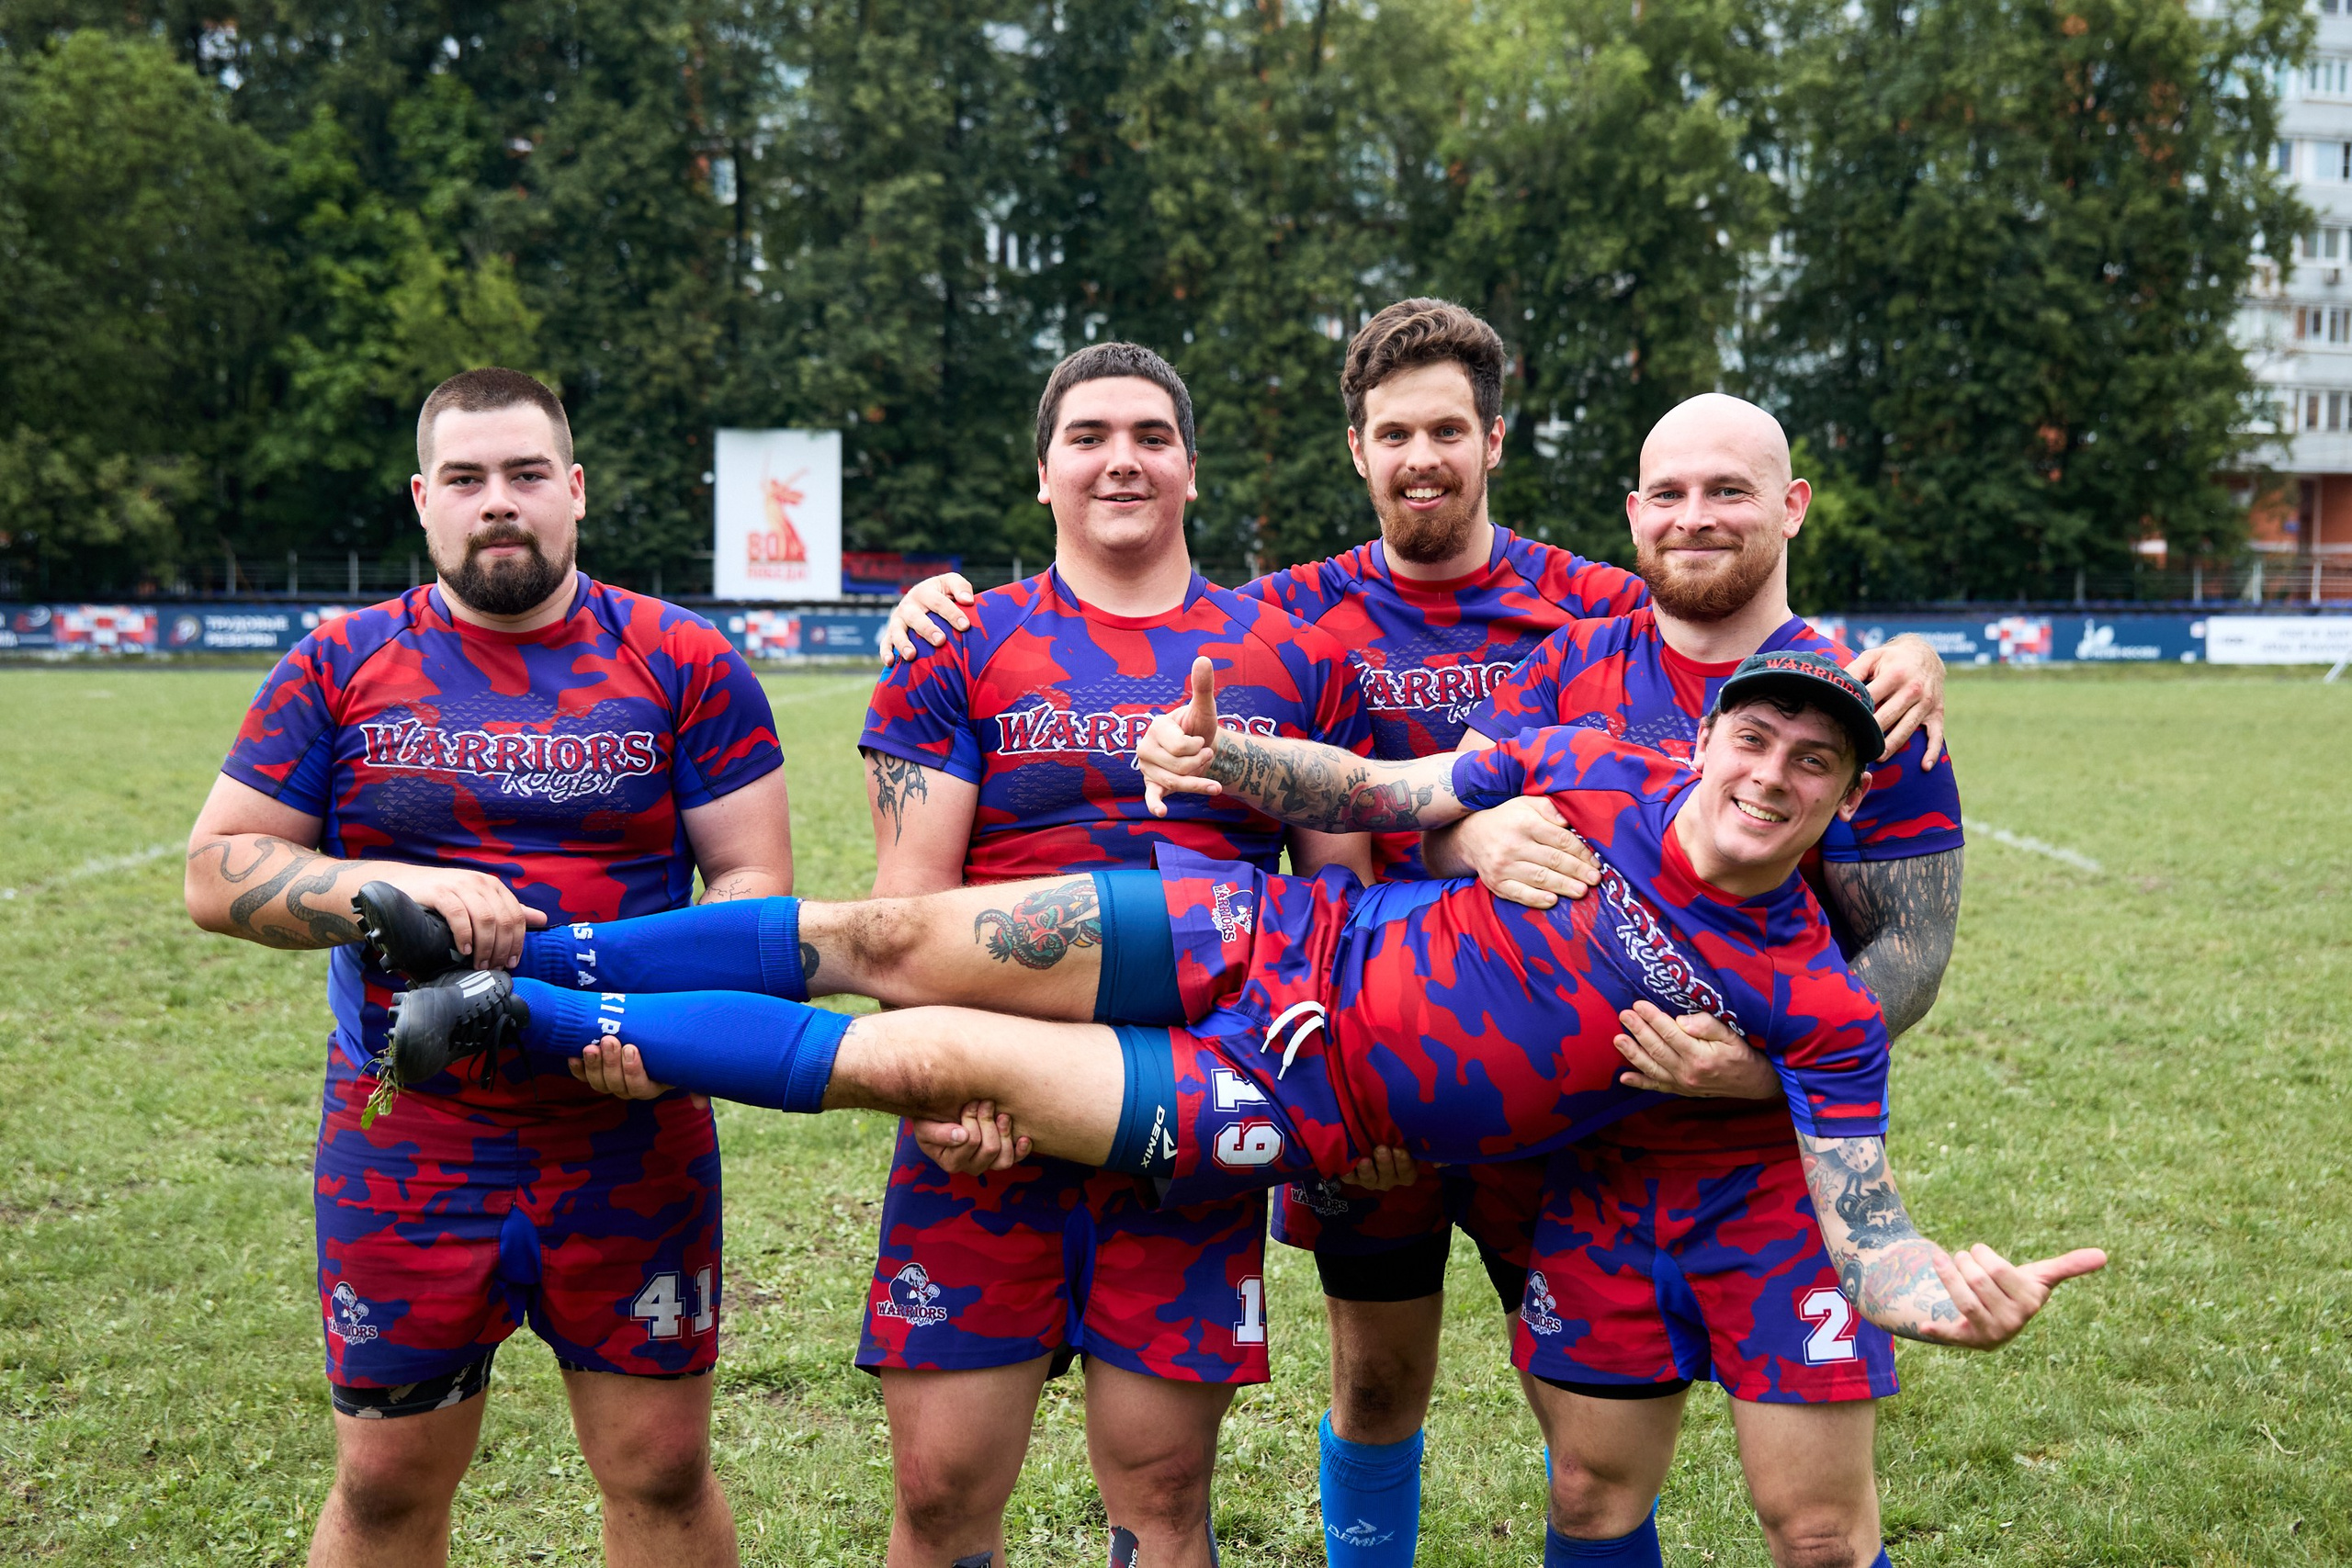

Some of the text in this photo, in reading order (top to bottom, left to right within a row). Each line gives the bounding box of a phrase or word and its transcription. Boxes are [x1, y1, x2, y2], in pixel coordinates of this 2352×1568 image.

[359, 717, 657, 777] WARRIORS
[1213, 884, 1237, 943] WARRIORS
[1140, 1104, 1166, 1168] DEMIX
[1211, 1068, 1284, 1167] 19
[630, 1263, 714, 1341] 41
[876, 1299, 947, 1321] WARRIORS
[1799, 1287, 1858, 1365] 2
[1327, 1523, 1395, 1547] DEMIX
